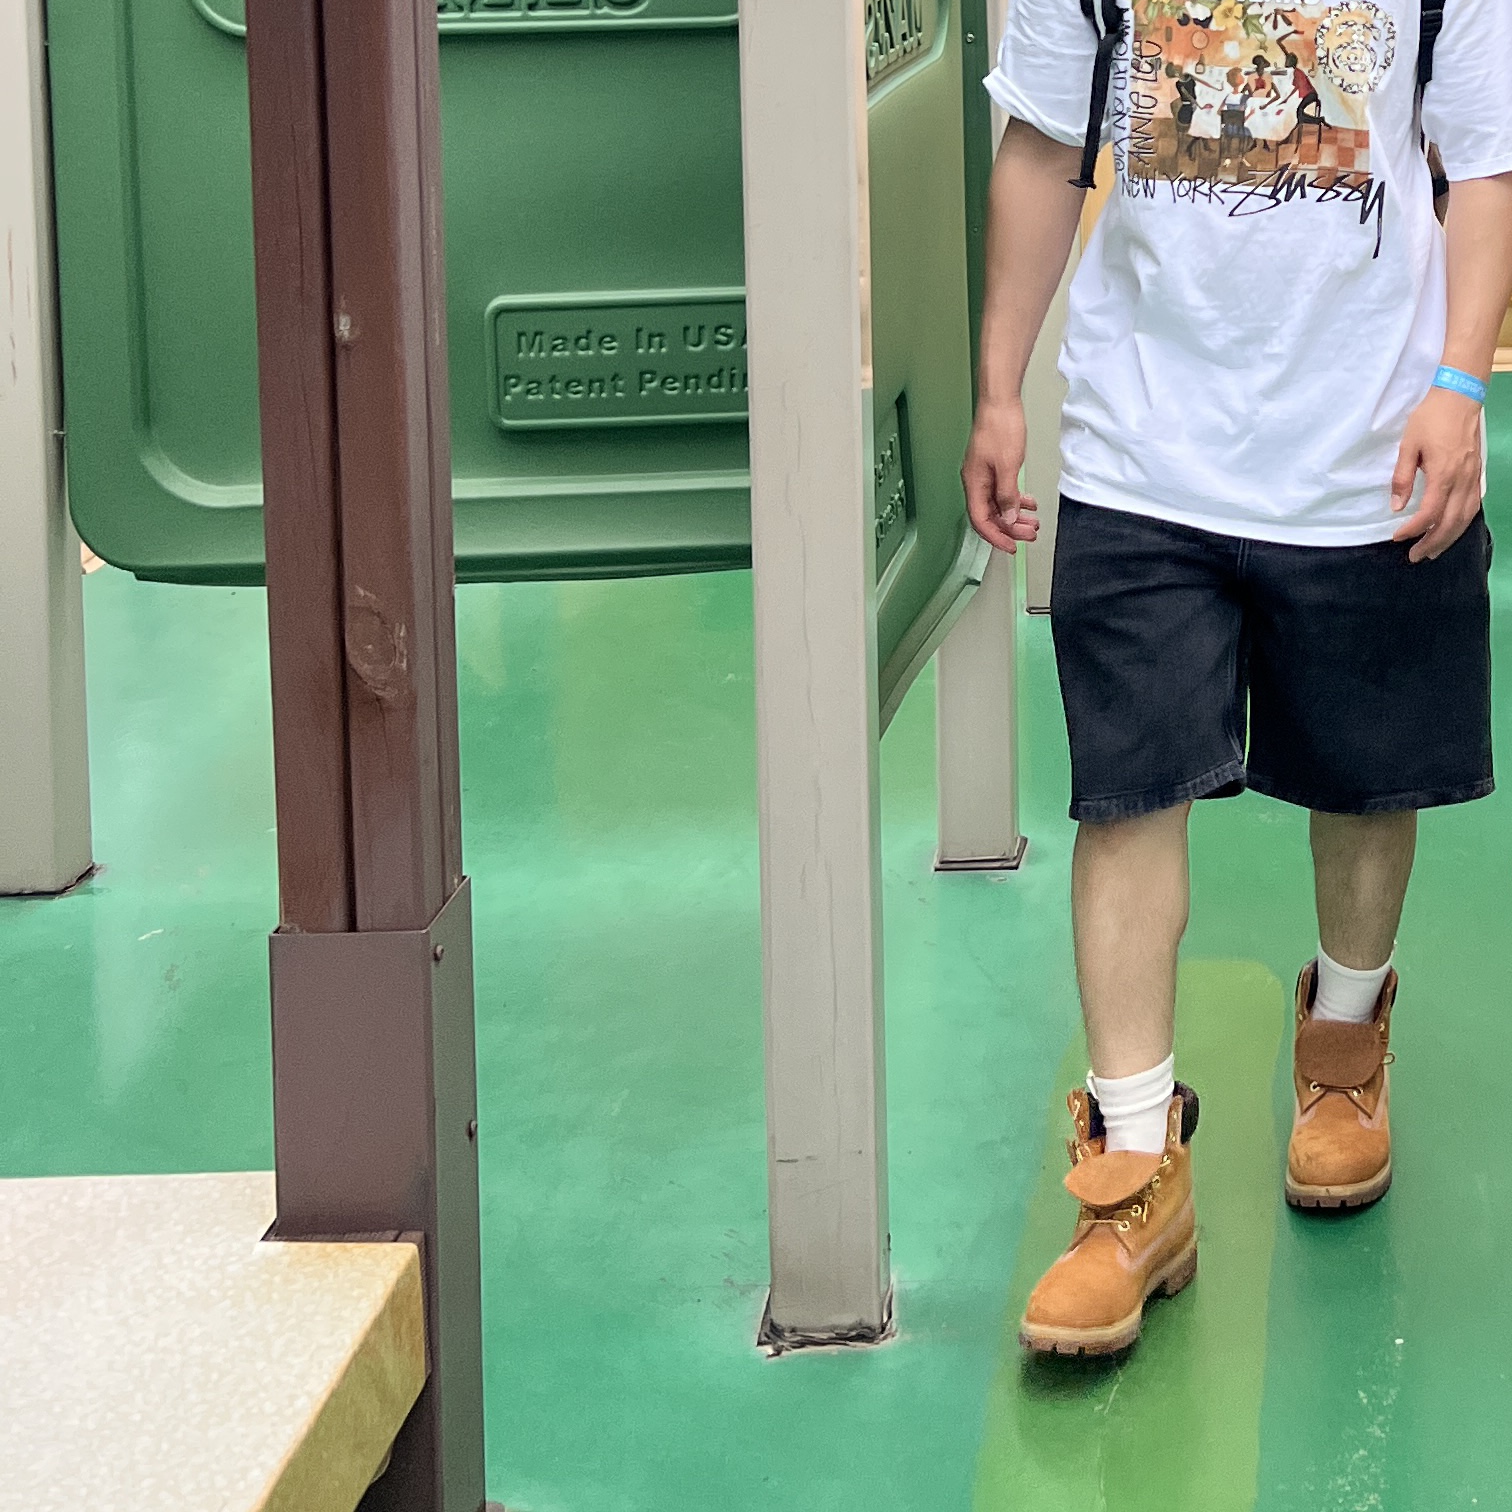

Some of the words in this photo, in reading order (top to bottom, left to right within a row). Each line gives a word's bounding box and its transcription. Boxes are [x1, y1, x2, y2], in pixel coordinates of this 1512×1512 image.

[1163, 171, 1225, 205] YORK
[515, 329, 619, 358] Made
[681, 323, 748, 352] US
[502, 372, 626, 402] Patent
[638, 366, 749, 397] Pendi
